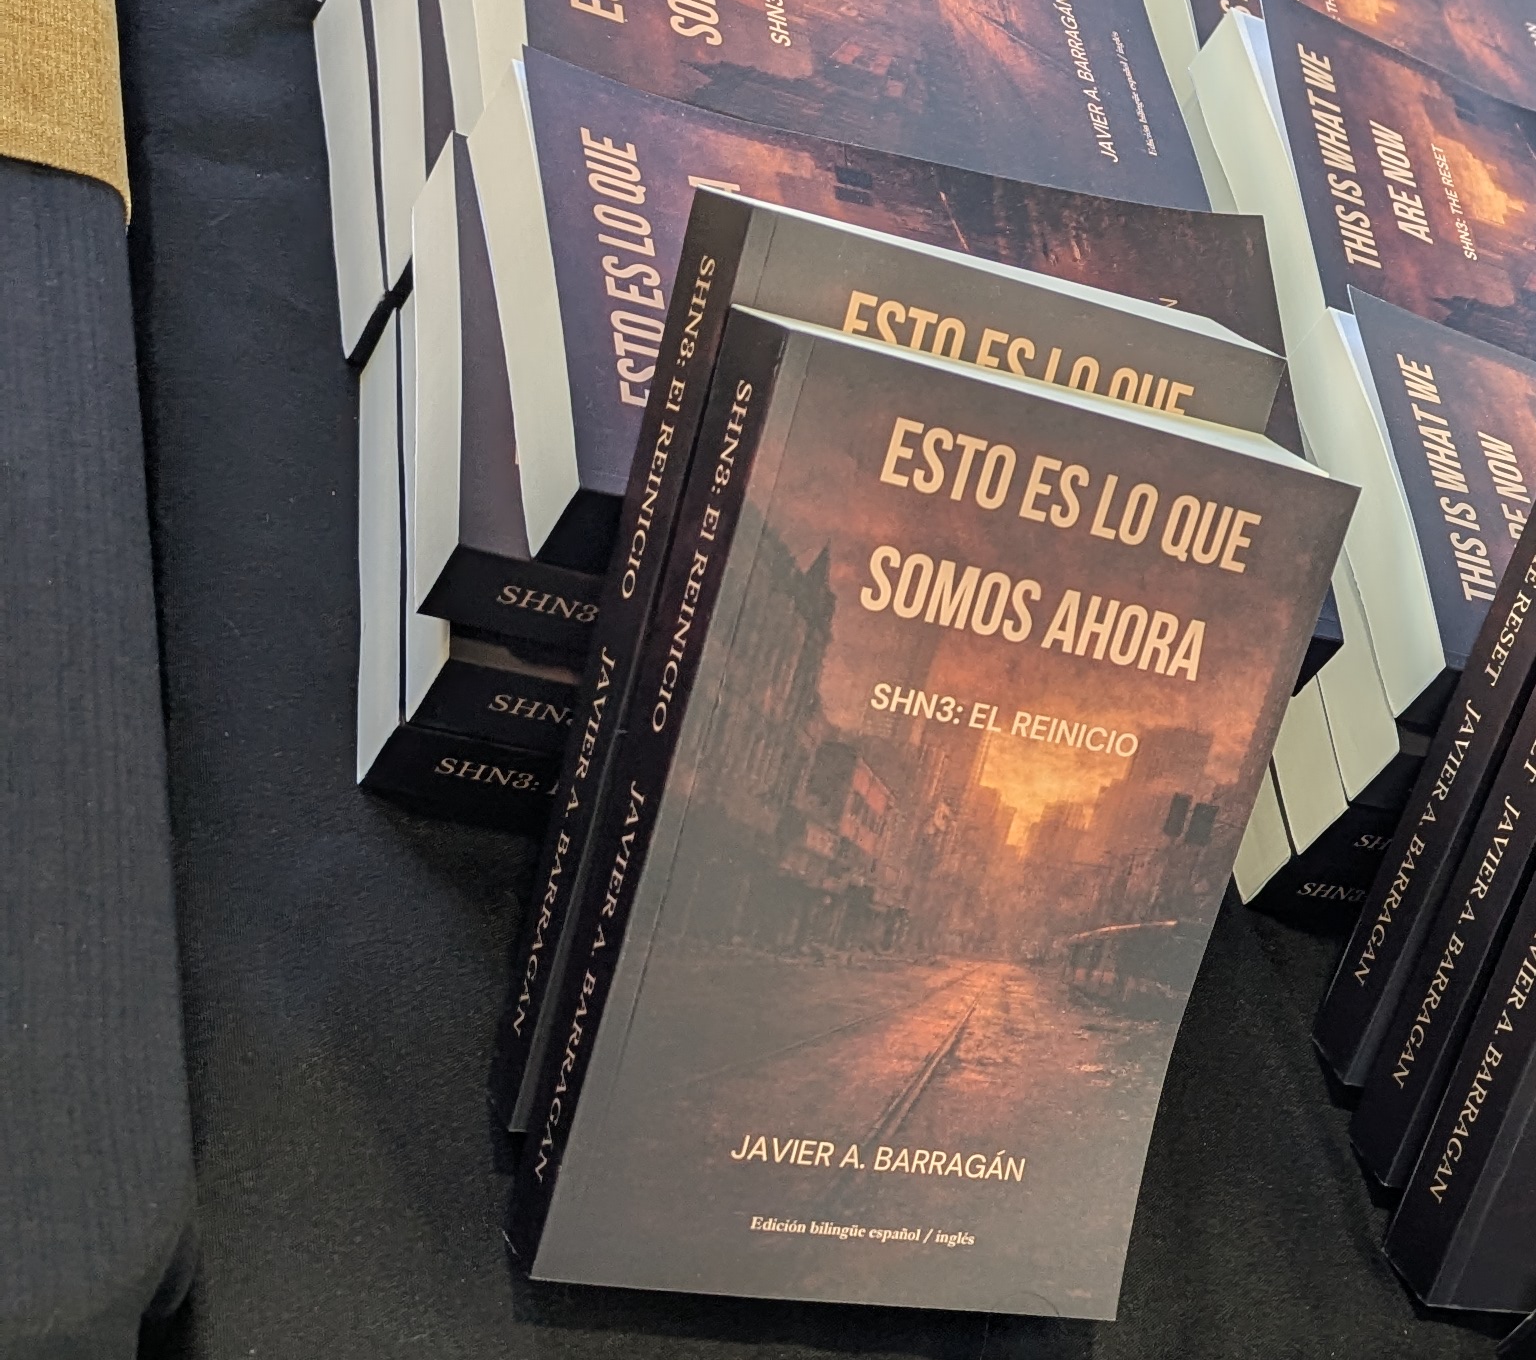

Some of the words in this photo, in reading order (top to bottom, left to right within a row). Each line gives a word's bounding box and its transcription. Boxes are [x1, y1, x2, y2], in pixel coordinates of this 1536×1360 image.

[1083, 86, 1101, 102] A.
[1298, 42, 1336, 93] WE
[1087, 102, 1119, 163] JAVIER
[1307, 88, 1357, 174] WHAT
[1369, 119, 1417, 188] NOW
[1327, 173, 1366, 207] IS
[1430, 143, 1455, 187] RESET
[1387, 184, 1434, 245] ARE
[1446, 186, 1464, 215] THE
[1335, 205, 1382, 269] THIS
[1456, 219, 1478, 261] SHN3:
[1397, 353, 1442, 404] WE
[1411, 403, 1470, 494] WHAT
[1477, 431, 1532, 504] NOW
[879, 416, 1017, 510] ESTO
[1018, 454, 1090, 529] ES
[1089, 473, 1160, 546] LO
[1160, 494, 1262, 573] QUE
[1439, 497, 1480, 531] IS
[1450, 532, 1497, 602] THIS
[860, 545, 1042, 643] SOMOS
[1041, 589, 1207, 682] AHORA
[1484, 590, 1532, 687] RESET
[870, 682, 964, 726] SHN3:
[968, 702, 1002, 732] EL
[1010, 710, 1139, 758] REINICIO
[434, 756, 541, 791] SHN3:
[1431, 699, 1482, 806] JAVIER
[1418, 802, 1437, 826] A.
[1469, 795, 1522, 900] JAVIER
[1354, 833, 1426, 987] BARRAGAN
[1458, 901, 1477, 926] A.
[1391, 931, 1466, 1089] BARRAGAN
[731, 1134, 835, 1166] JAVIER
[839, 1144, 866, 1170] A.
[873, 1148, 1027, 1182] BARRAGÁN
[750, 1216, 807, 1234] Edición
[810, 1221, 866, 1240] bilingüe
[868, 1227, 921, 1243] español
[922, 1228, 934, 1244] /
[935, 1230, 975, 1248] inglés
